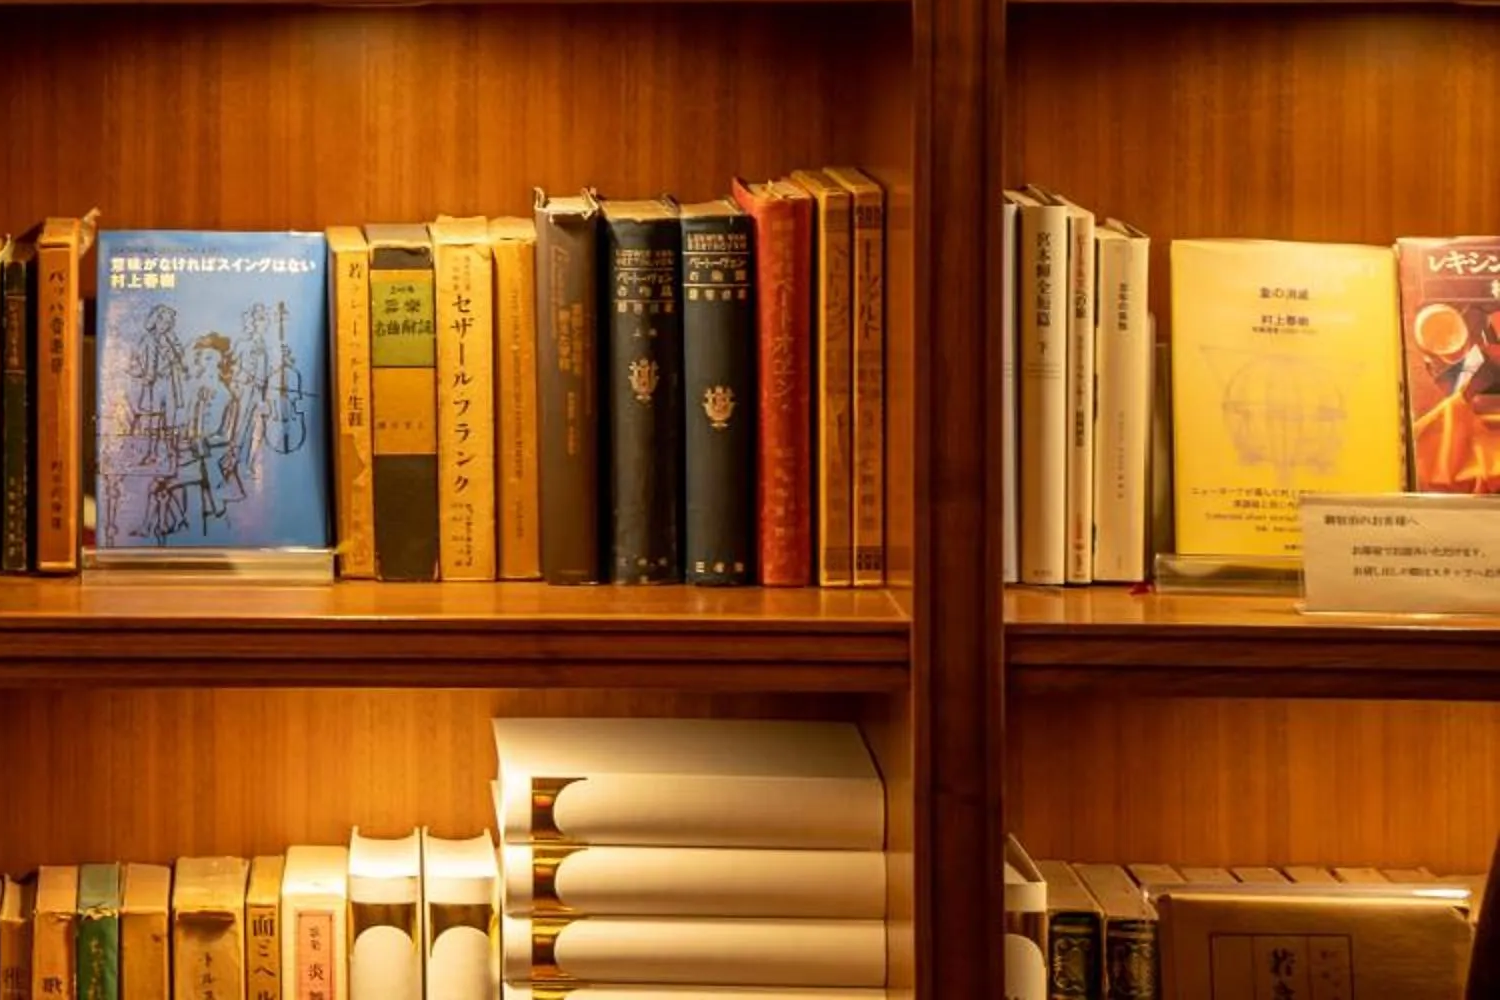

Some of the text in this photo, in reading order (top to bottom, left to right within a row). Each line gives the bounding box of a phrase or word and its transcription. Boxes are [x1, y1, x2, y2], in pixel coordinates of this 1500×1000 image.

[108, 255, 317, 274] 意味がなければスイングはない
[109, 273, 177, 290] 村上春樹
